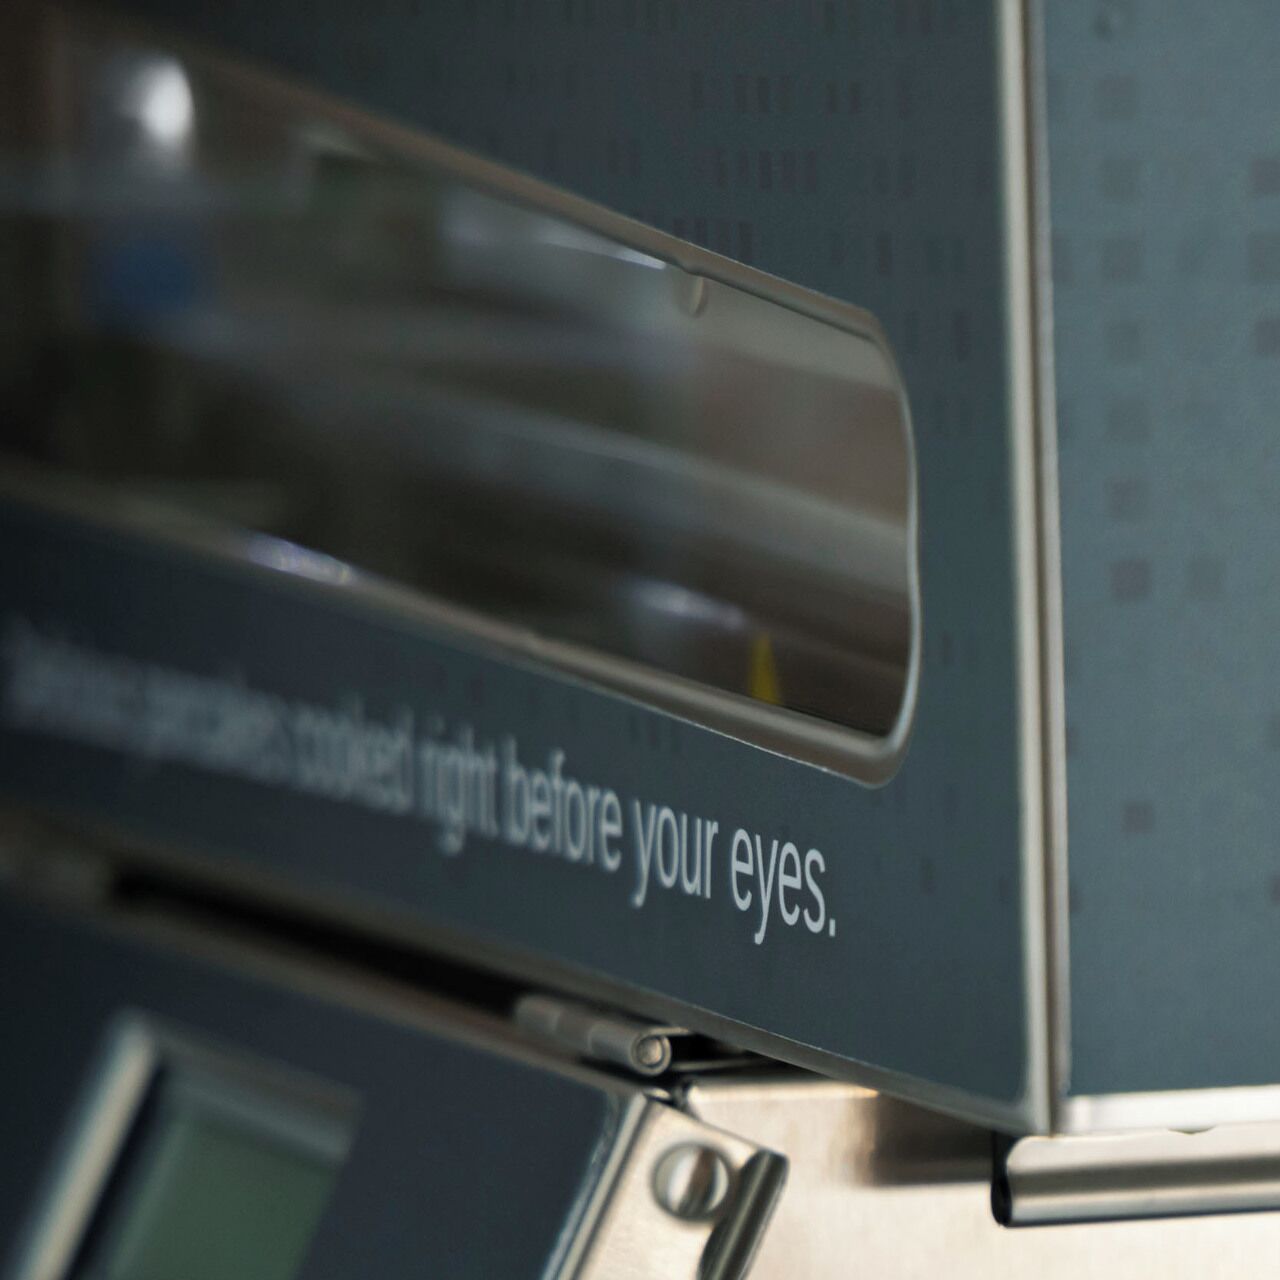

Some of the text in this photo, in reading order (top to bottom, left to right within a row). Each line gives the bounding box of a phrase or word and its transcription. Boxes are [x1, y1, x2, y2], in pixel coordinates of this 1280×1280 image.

[418, 710, 499, 857] right
[500, 732, 623, 873] before
[631, 797, 720, 909] your
[730, 827, 837, 945] eyes.
